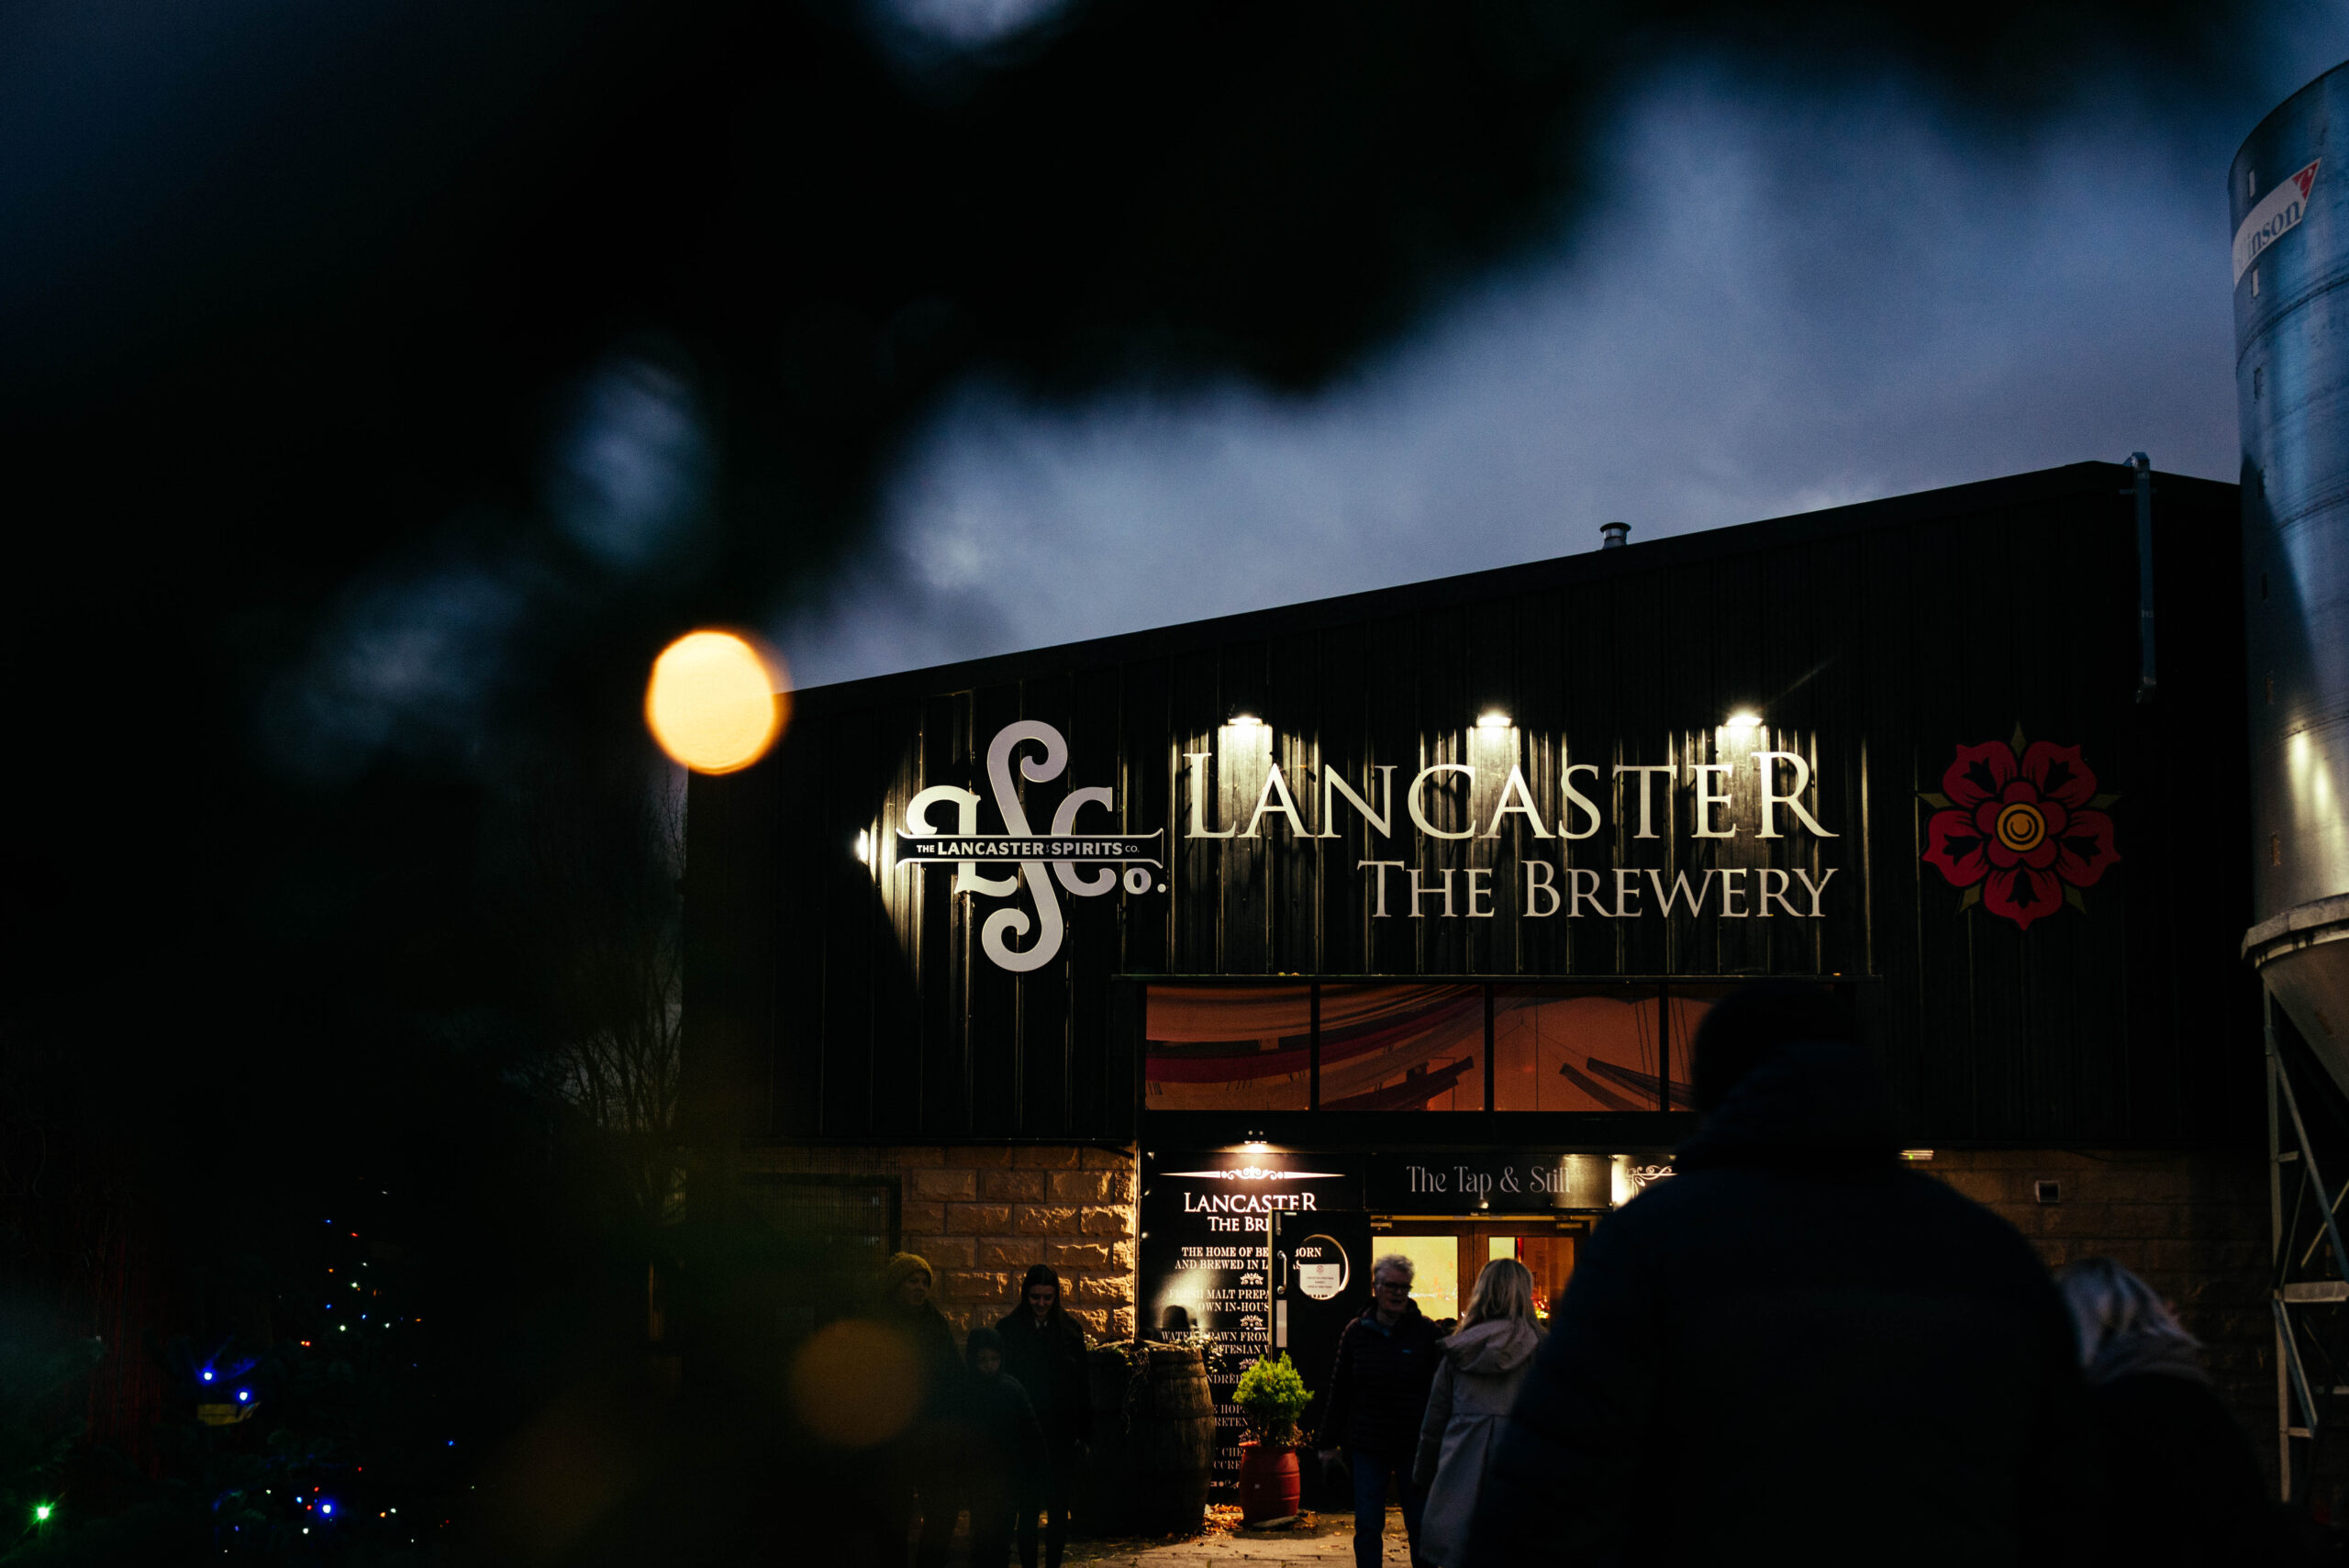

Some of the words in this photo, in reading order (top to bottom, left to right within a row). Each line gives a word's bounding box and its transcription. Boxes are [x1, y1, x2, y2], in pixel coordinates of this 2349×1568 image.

[1183, 751, 1841, 839] LANCASTER
[917, 844, 935, 853] THE
[938, 841, 1044, 855] LANCASTER
[1052, 841, 1122, 855] SPIRITS
[1357, 860, 1496, 918] THE
[1521, 860, 1841, 918] BREWERY
[1406, 1165, 1447, 1193] The
[1453, 1165, 1492, 1200] Tap
[1499, 1165, 1522, 1193] &
[1530, 1165, 1571, 1193] Still
[1183, 1192, 1318, 1213] LANCASTER
[1207, 1216, 1240, 1231] THE
[1182, 1246, 1202, 1258] THE
[1206, 1246, 1235, 1258] HOME
[1239, 1246, 1252, 1258] OF
[1175, 1259, 1197, 1270] AND
[1200, 1259, 1244, 1270] BREWED
[1247, 1259, 1259, 1270] IN
[1208, 1289, 1236, 1299] MALT
